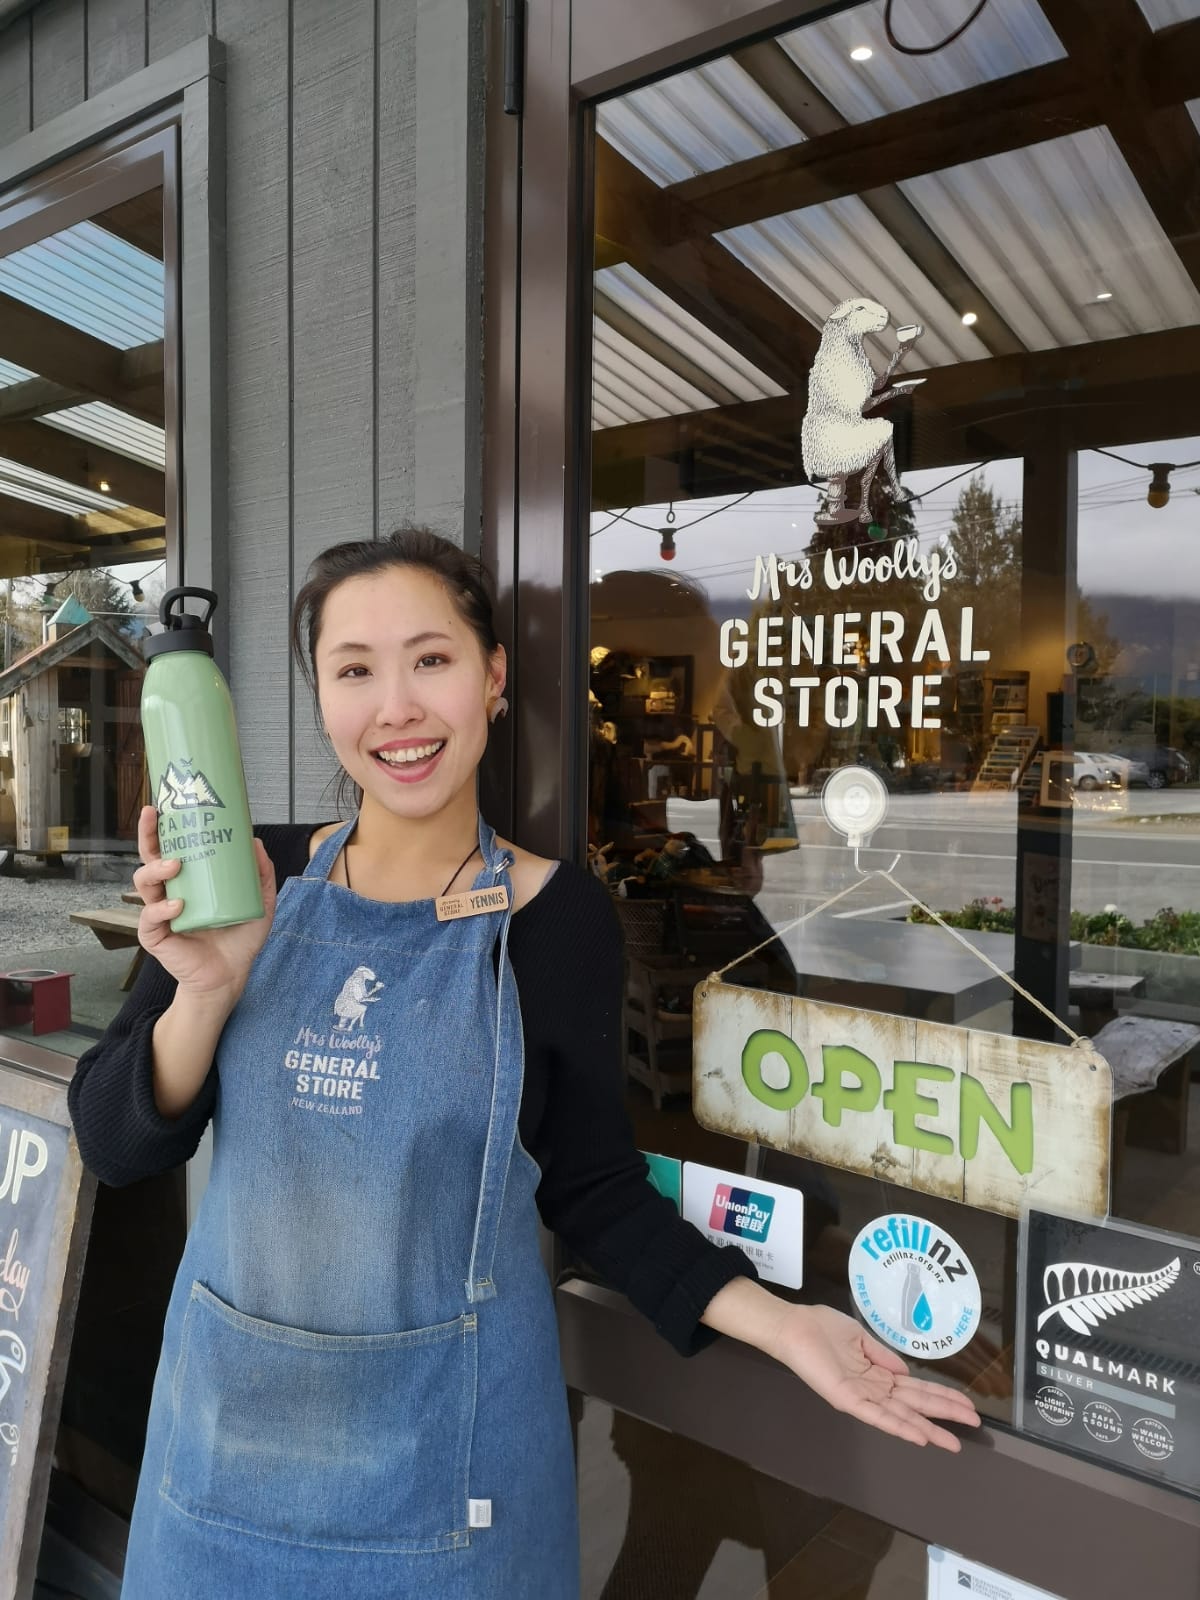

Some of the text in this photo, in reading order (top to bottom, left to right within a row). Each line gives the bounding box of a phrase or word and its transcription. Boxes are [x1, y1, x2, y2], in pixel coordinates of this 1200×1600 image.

[746, 552, 813, 600] Mrs
[719, 606, 991, 669] GENERAL
[752, 675, 943, 729] STORE
[159, 812, 215, 837] CAMP
[470, 892, 504, 909] YENNIS
[293, 1026, 326, 1047] Mrs
[285, 1050, 380, 1080] GENERAL
[296, 1074, 364, 1100] STORE
[291, 1097, 363, 1115] NEW ZEALAND
[741, 1029, 1034, 1175] OPEN
[715, 1194, 770, 1225] UnionPay
[734, 1214, 765, 1234] 银联
[883, 1251, 944, 1284] refillnz.org.nz
[856, 1274, 973, 1352] FREE WATER ON TAP HERE
[1035, 1339, 1175, 1396] QUALMARK
[1040, 1365, 1093, 1389] SILVER
[1035, 1400, 1075, 1418] FOOTPRINT
[1044, 1396, 1065, 1408] LIGHT
[1090, 1418, 1122, 1434] SOUND
[1092, 1412, 1114, 1425] SAFE
[1131, 1432, 1174, 1452] WELCOME
[1140, 1428, 1166, 1442] WARM
